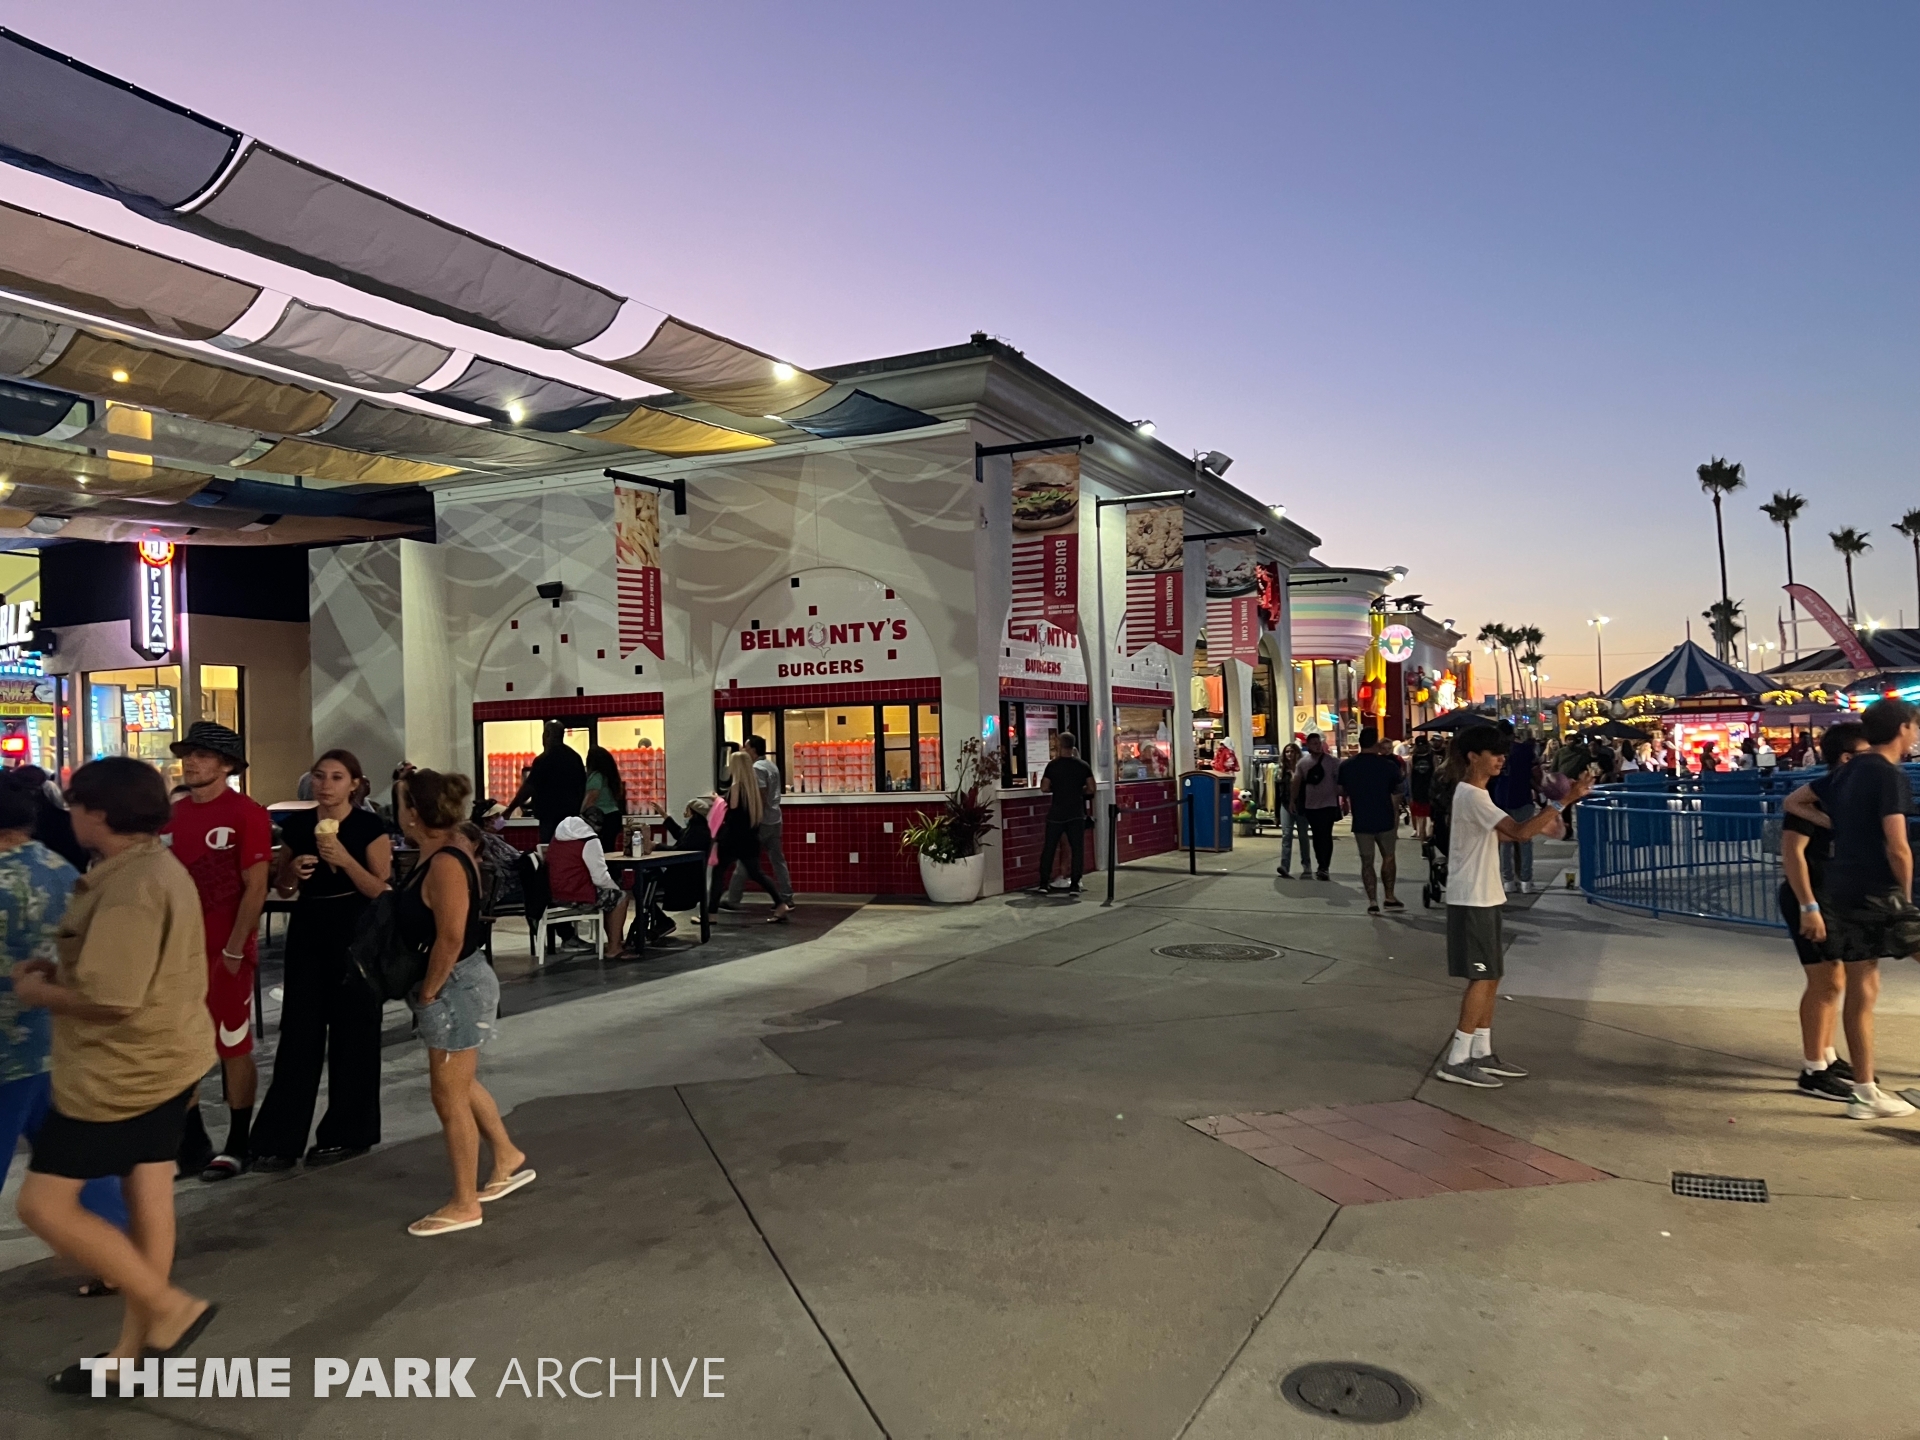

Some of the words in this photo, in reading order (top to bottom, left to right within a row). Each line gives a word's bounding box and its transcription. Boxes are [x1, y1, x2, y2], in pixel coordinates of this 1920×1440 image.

[1054, 539, 1067, 598] BURGERS
[1166, 575, 1174, 600] CHICKEN
[150, 567, 164, 638] PIZZA
[1166, 602, 1174, 627] TENDERS
[1241, 600, 1249, 624] FUNNEL
[741, 618, 908, 651] BELMONTY'S
[1241, 625, 1249, 641] CAKE
[778, 659, 864, 678] BURGERS
[1025, 658, 1062, 676] BURGERS
